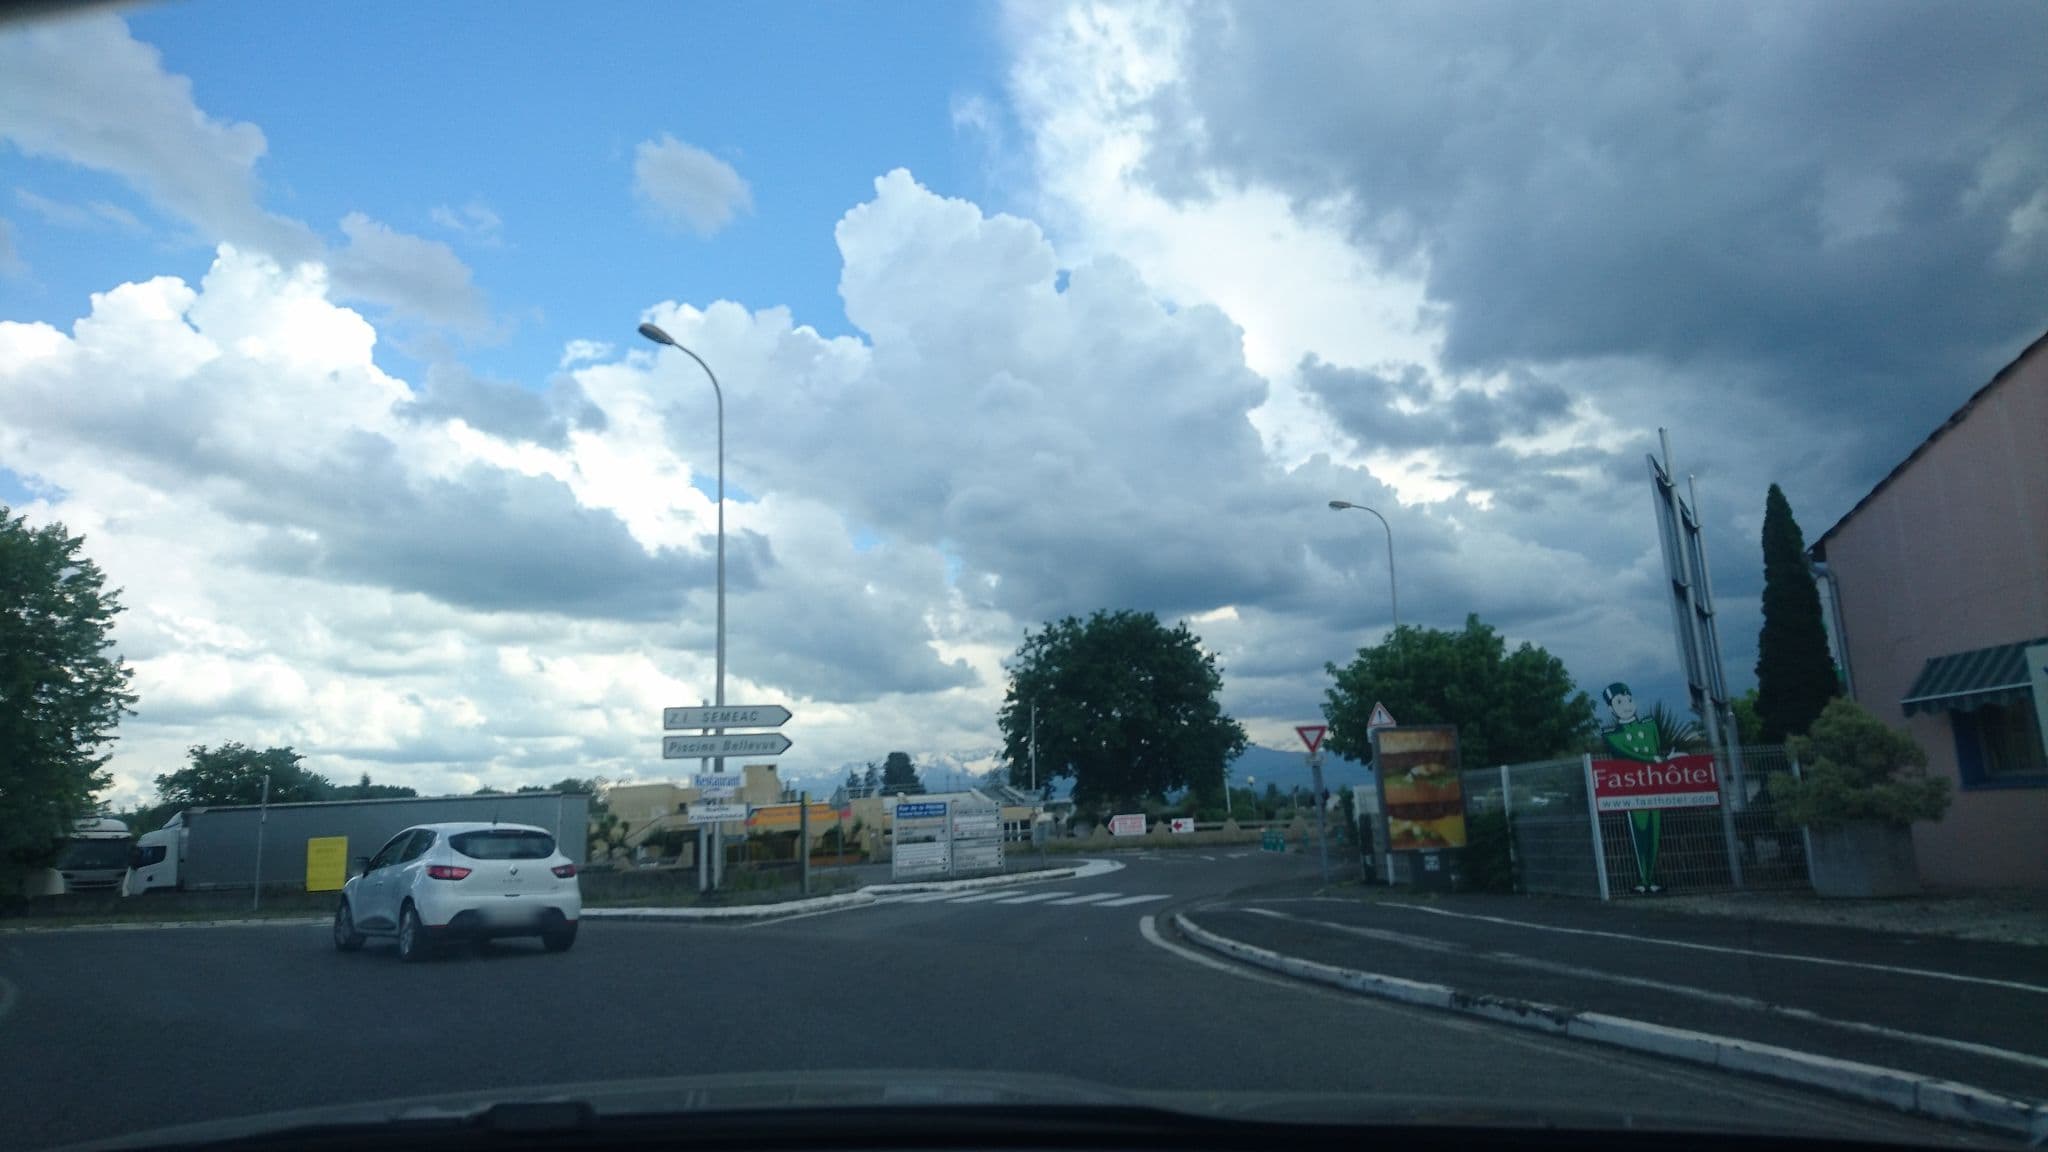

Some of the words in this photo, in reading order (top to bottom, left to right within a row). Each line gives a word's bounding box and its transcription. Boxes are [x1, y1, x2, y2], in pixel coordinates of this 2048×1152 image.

[703, 710, 760, 722] SEMEAC
[668, 741, 716, 752] Piscine
[722, 739, 776, 751] Bellevue
[1593, 761, 1716, 788] Fasthôtel
